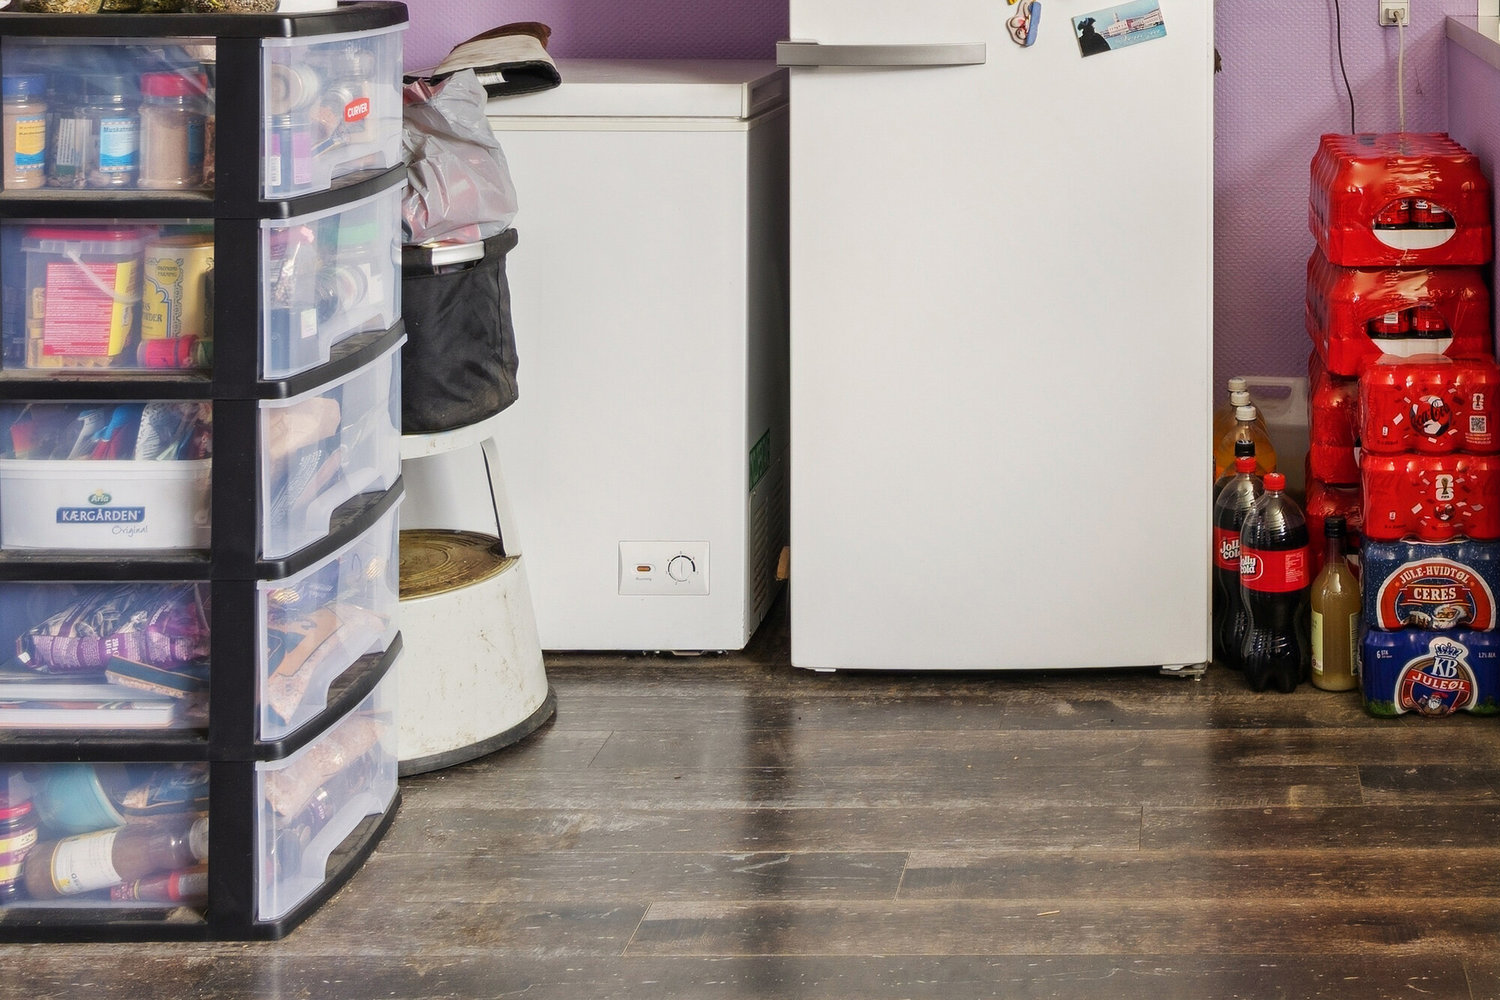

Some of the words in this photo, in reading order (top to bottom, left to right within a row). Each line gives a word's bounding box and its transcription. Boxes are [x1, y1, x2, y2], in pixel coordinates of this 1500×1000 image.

[347, 102, 368, 118] CURVER
[91, 495, 109, 503] Arla
[62, 508, 138, 521] KÆRGÅRDEN
[112, 525, 148, 537] Original
[1399, 565, 1471, 584] JULE-HVIDTØL
[1413, 587, 1457, 600] CERES
[1376, 650, 1381, 658] 6
[1430, 657, 1459, 678] KB
[1412, 673, 1465, 690] JULEØL
